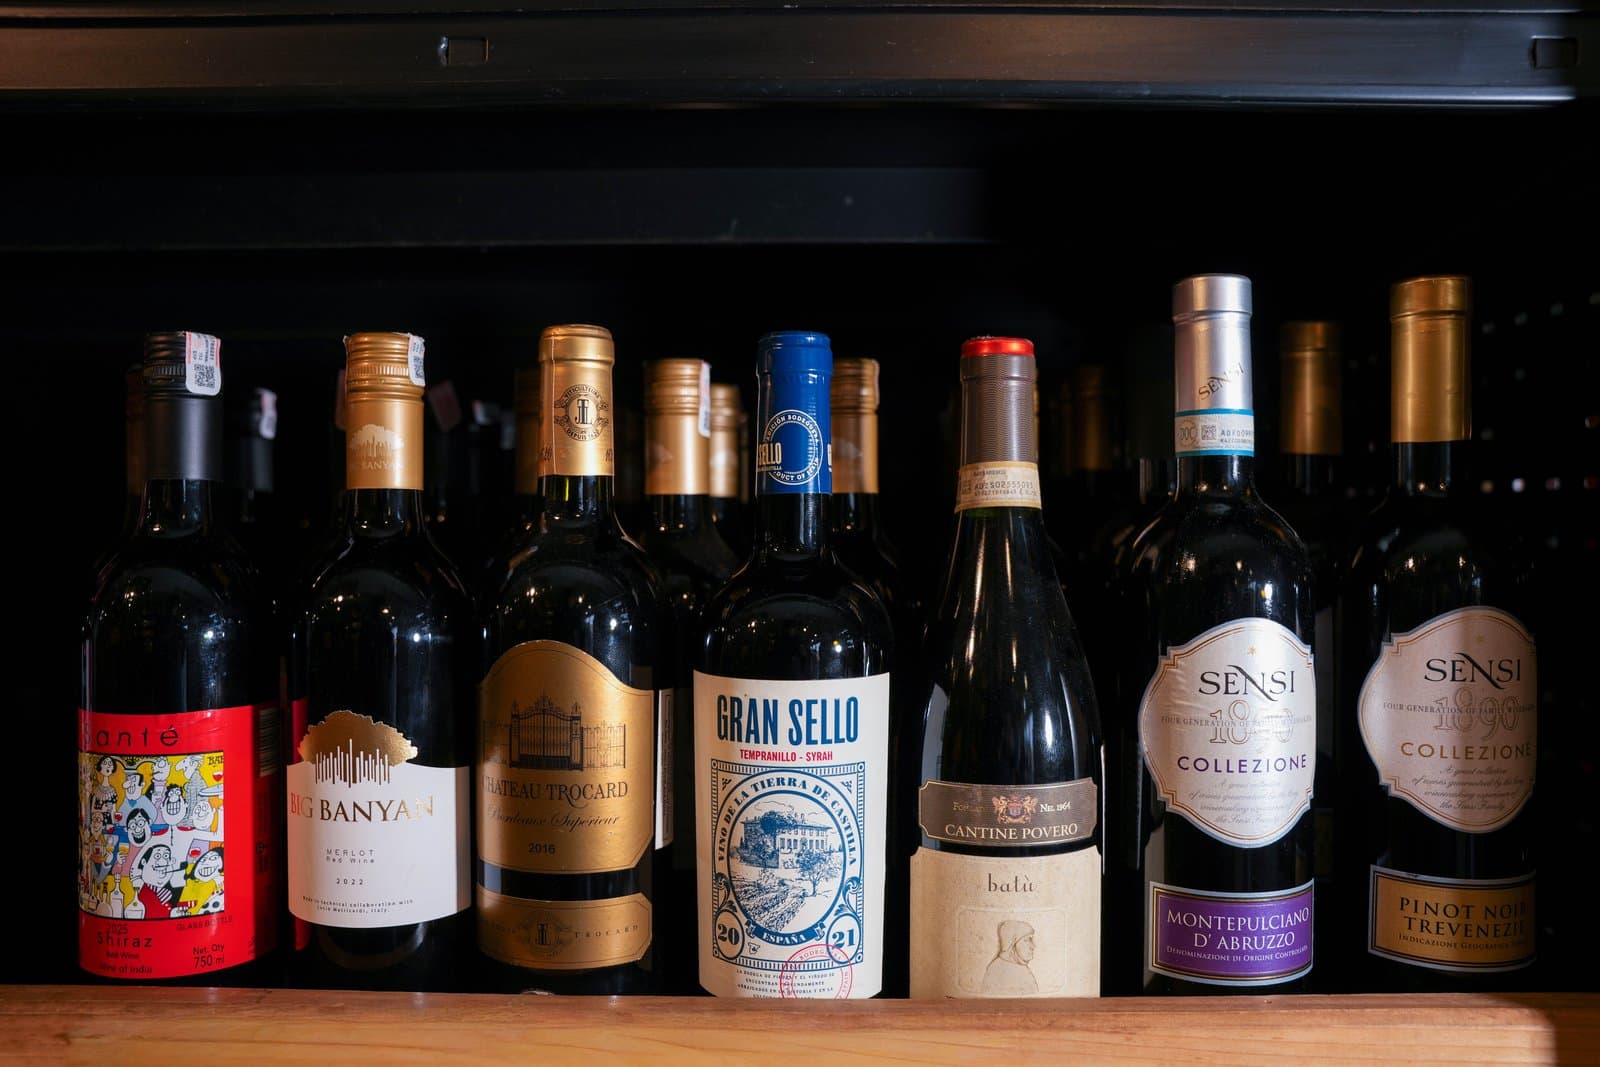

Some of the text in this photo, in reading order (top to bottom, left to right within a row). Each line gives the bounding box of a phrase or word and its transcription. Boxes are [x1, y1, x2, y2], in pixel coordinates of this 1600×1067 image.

[1423, 653, 1521, 689] SENSI
[1198, 664, 1295, 702] SENSI
[1406, 704, 1463, 714] GENERATION
[1432, 686, 1520, 741] 1890
[717, 694, 859, 746] GRAN SELLO
[1183, 717, 1238, 728] GENERATION
[739, 748, 797, 762] TEMPRANILLO
[805, 750, 833, 762] SYRAH
[1400, 741, 1532, 761] COLLEZIONE
[1177, 753, 1308, 774] COLLEZIONE
[545, 781, 628, 809] TROCARD
[290, 792, 434, 823] BIG BANYAN
[717, 776, 857, 866] VINO DE LA TIERRA DE CASTILLA
[944, 822, 1079, 841] CANTINE POVERO
[326, 849, 375, 857] MERLOT
[528, 841, 556, 855] 2016
[335, 877, 364, 886] 2022
[987, 872, 1036, 894] batù
[1400, 896, 1476, 920] PINOT
[1167, 906, 1309, 931] MONTEPULCIANO
[96, 931, 153, 948] Shiraz
[574, 923, 639, 939] TROCARD
[717, 923, 740, 946] 20
[762, 930, 808, 945] ESPAÑA
[831, 929, 856, 950] 21
[1216, 931, 1295, 951] ABRUZZO
[193, 955, 213, 969] 750
